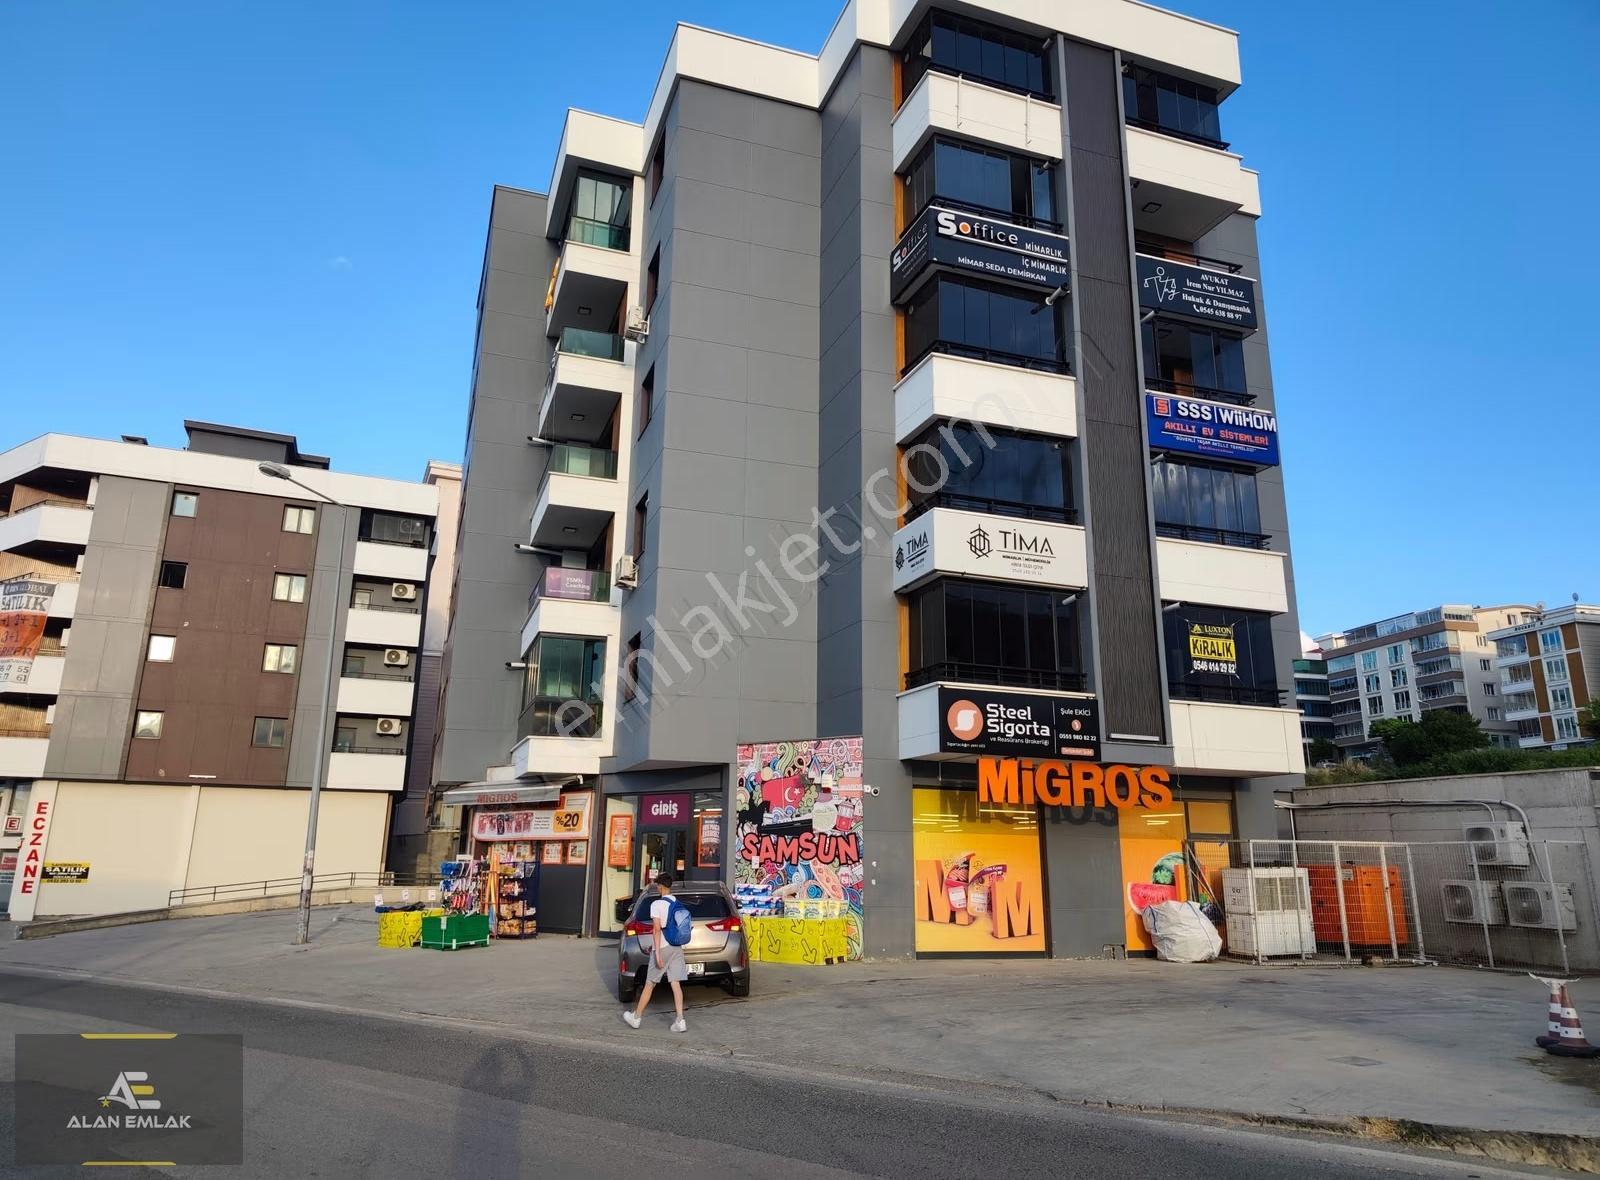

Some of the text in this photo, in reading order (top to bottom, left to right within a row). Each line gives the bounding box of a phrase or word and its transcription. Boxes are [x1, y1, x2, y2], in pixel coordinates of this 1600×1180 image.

[1025, 242, 1062, 258] MİMARLIK
[958, 256, 1046, 282] MİMAR SEDA DEMİRKAN
[1031, 260, 1067, 275] MİMARLIK
[1200, 273, 1229, 286] AVUKAT
[1182, 293, 1204, 305] Hukuk
[1202, 282, 1215, 292] Nur
[1216, 285, 1245, 299] YILMAZ
[1177, 401, 1212, 421] SSS
[1164, 421, 1269, 446] AKILLI EV SİSTEMLERİ
[906, 531, 929, 555] TİMA
[998, 529, 1054, 555] TİMA
[986, 703, 1032, 720] Steel
[986, 719, 1051, 737] Sigorta
[651, 801, 679, 819] GİRİŞ
[21, 801, 49, 894] ECZANE
[741, 832, 860, 867] SAMSUN
